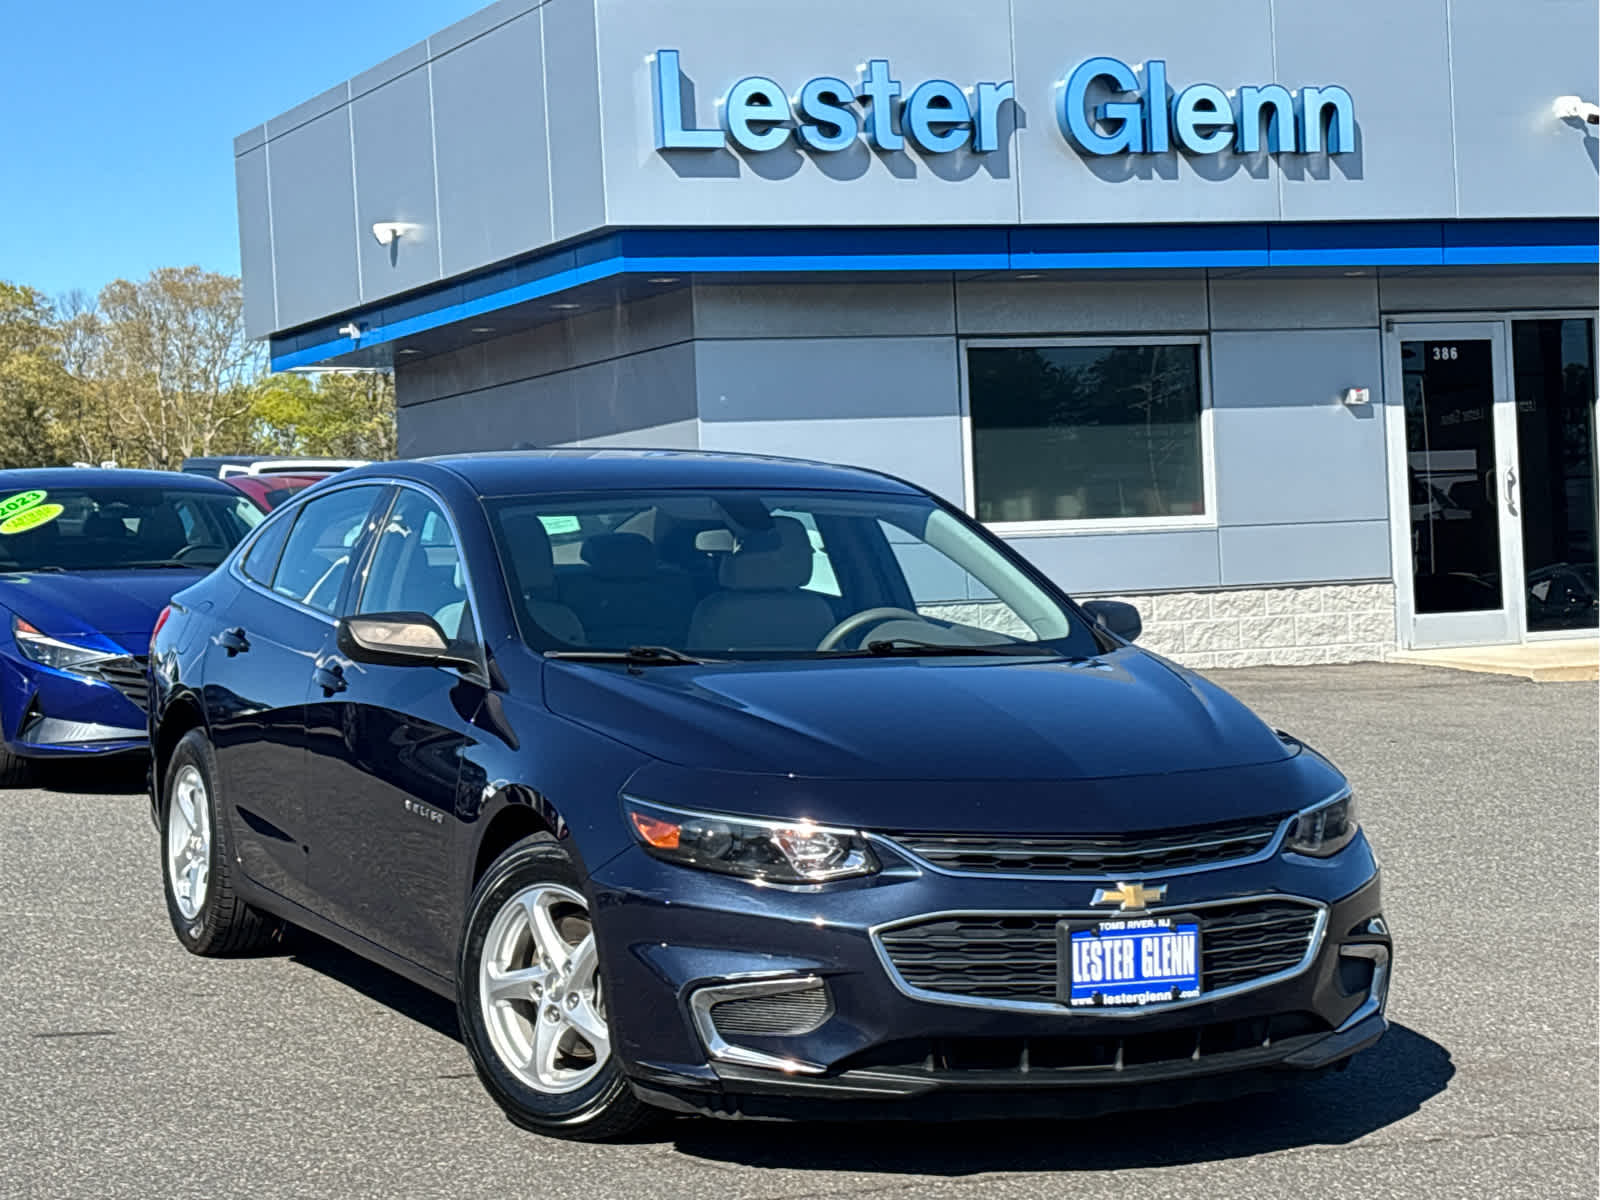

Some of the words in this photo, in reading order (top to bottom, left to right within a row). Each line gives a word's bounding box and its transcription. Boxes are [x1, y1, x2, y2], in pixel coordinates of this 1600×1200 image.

[654, 48, 1014, 154] Lester
[1060, 56, 1356, 157] Glenn
[1433, 346, 1458, 360] 386
[0, 493, 41, 516] 2023
[1099, 921, 1125, 931] TOMS
[1158, 919, 1170, 927] NJ
[1072, 938, 1135, 983] LESTER
[1141, 935, 1196, 978] GLENN
